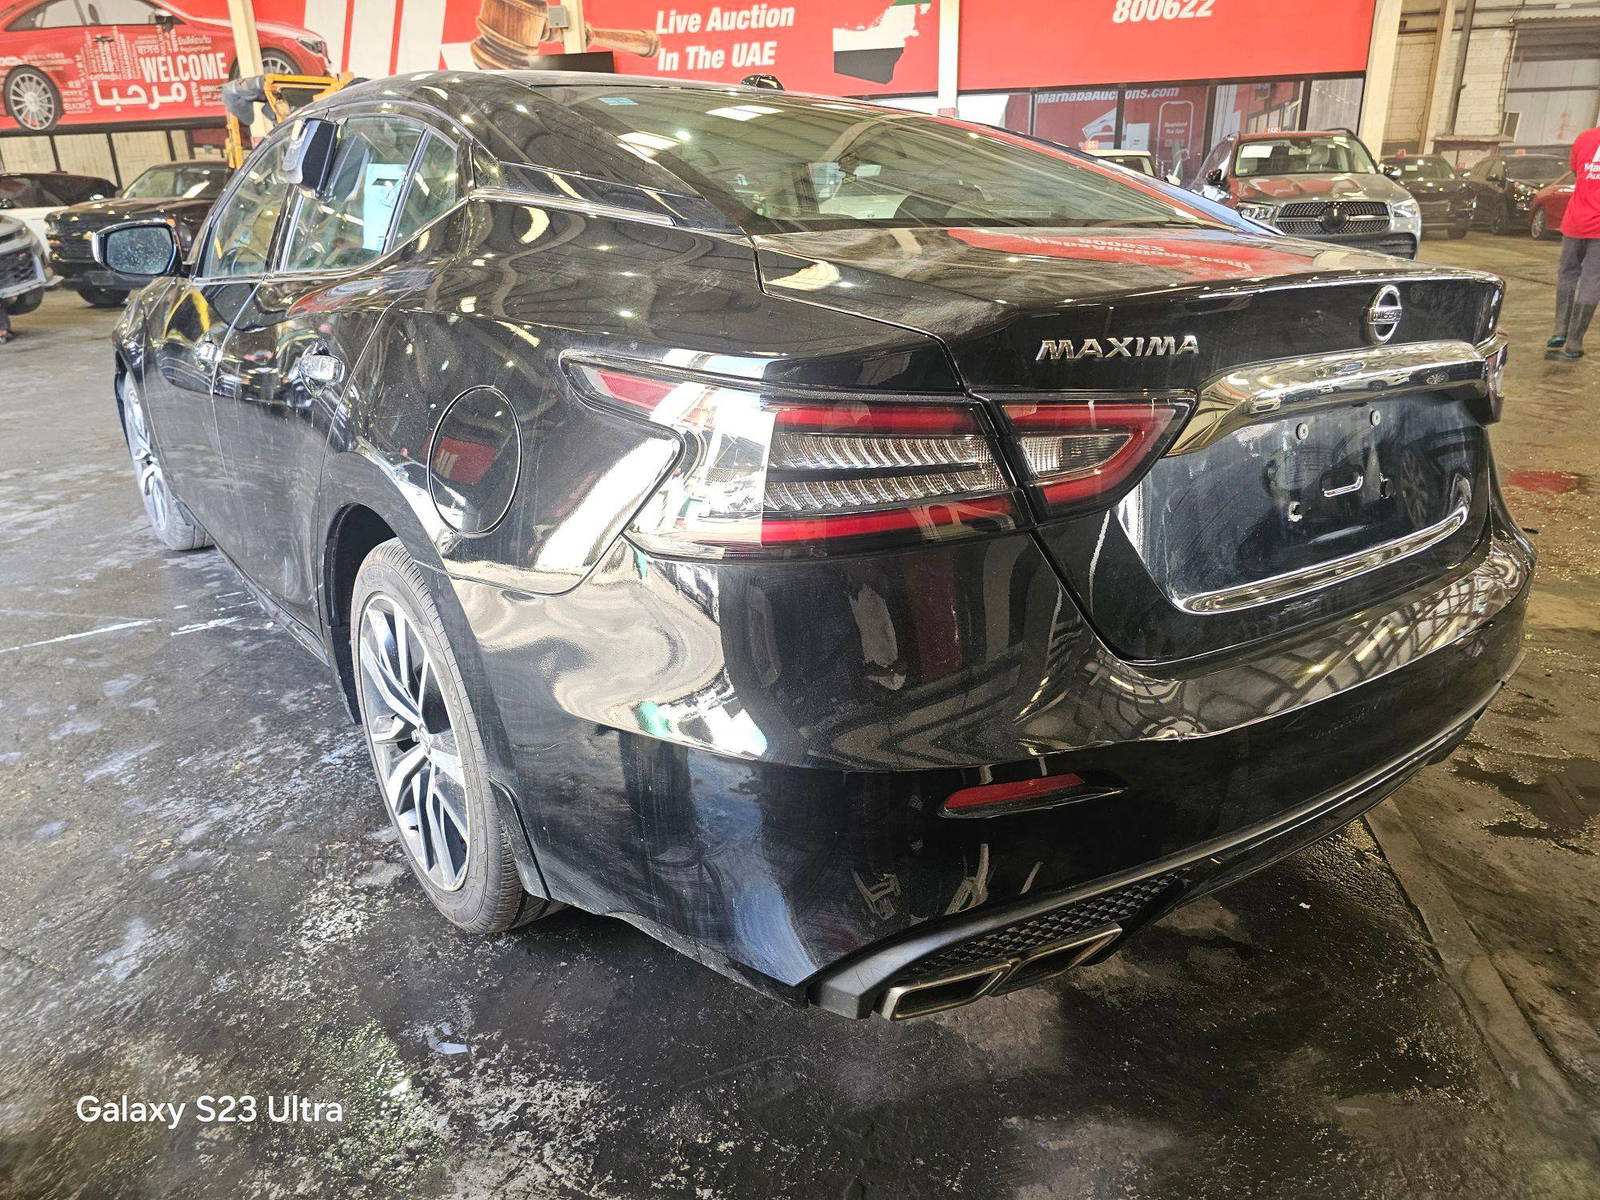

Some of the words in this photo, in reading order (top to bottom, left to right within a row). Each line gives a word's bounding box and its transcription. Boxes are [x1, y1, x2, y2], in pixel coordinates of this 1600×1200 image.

[656, 9, 701, 34] Live
[705, 3, 795, 31] Auction
[1112, 0, 1213, 23] 800622
[139, 52, 229, 83] WELCOME
[658, 47, 679, 71] In
[685, 45, 725, 70] The
[731, 41, 777, 67] UAE
[92, 80, 187, 111] مرحبا
[1035, 335, 1200, 361] MAXIMA
